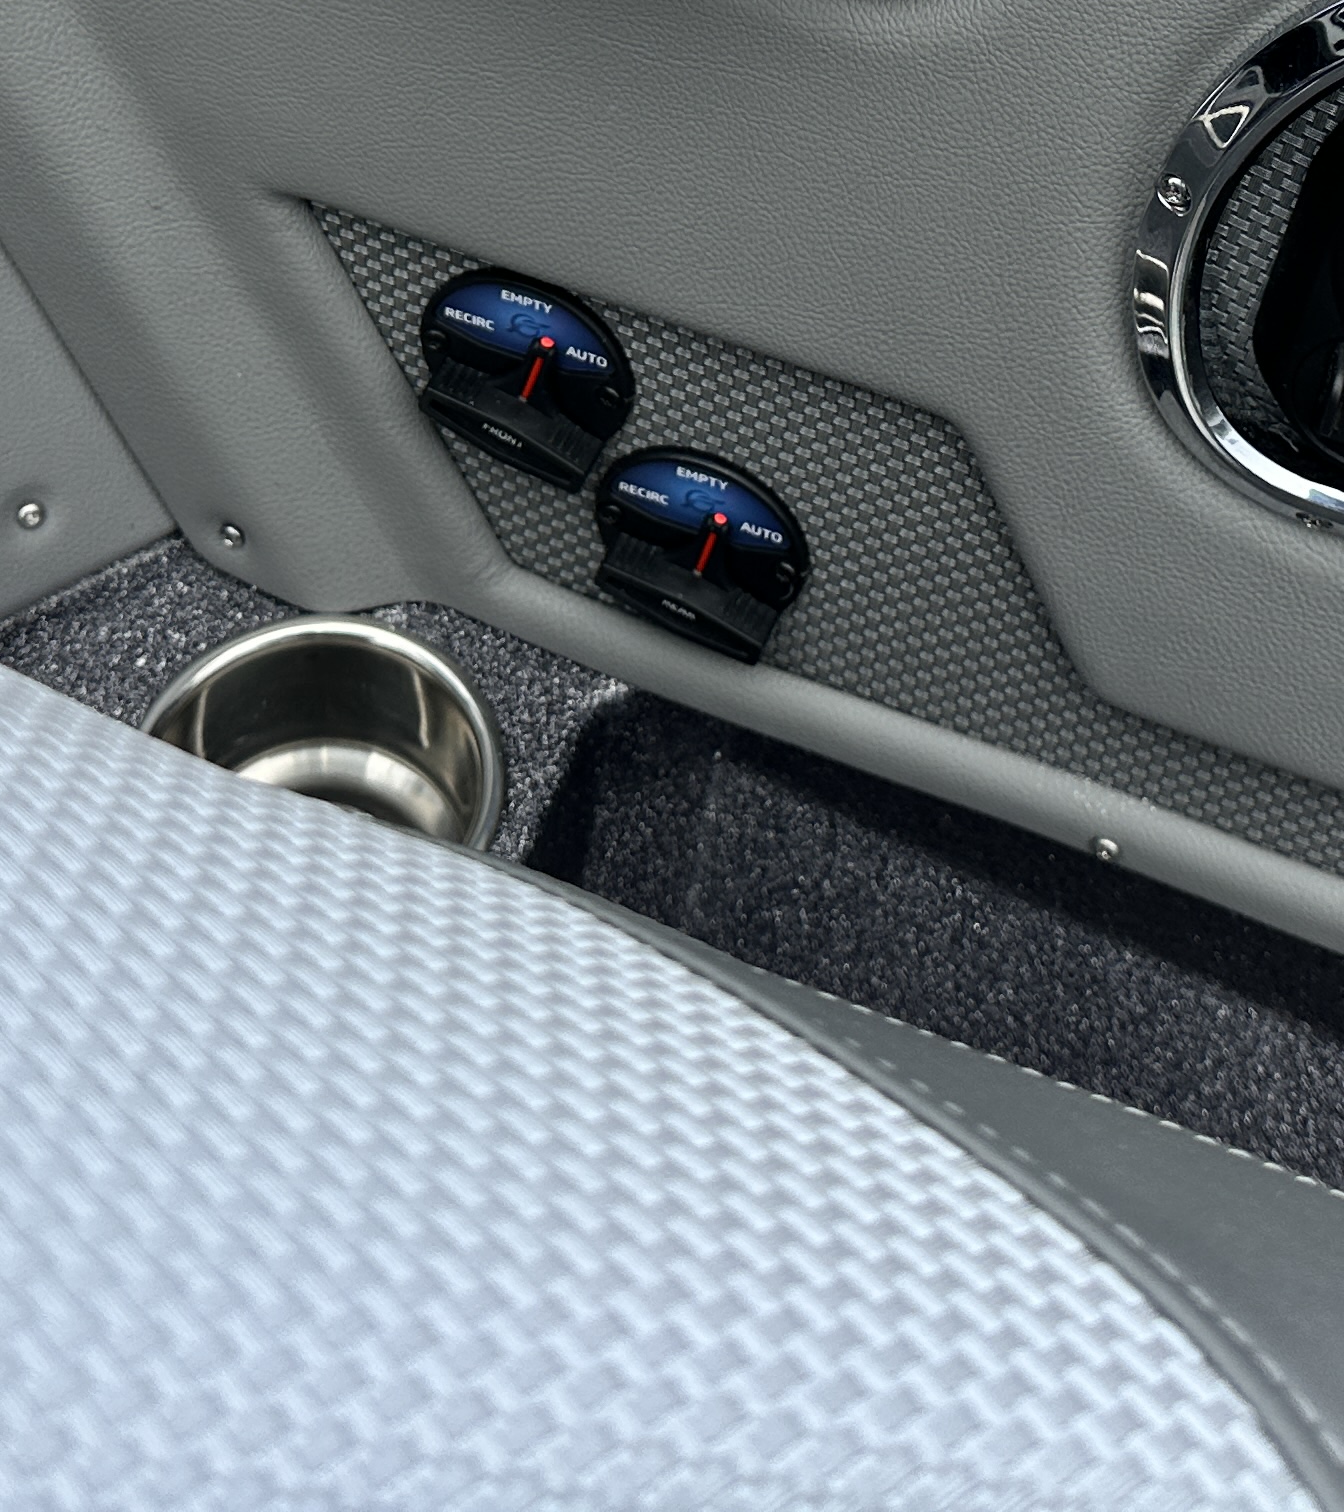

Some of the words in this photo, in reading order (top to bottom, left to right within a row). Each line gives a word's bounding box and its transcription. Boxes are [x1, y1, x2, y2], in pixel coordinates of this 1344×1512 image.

[500, 289, 553, 314] EMPTY
[443, 306, 495, 331] RECIRC
[565, 346, 608, 368] AUTO
[676, 465, 729, 490] EMPTY
[618, 481, 670, 506] RECIRC
[740, 522, 783, 544] AUTO
